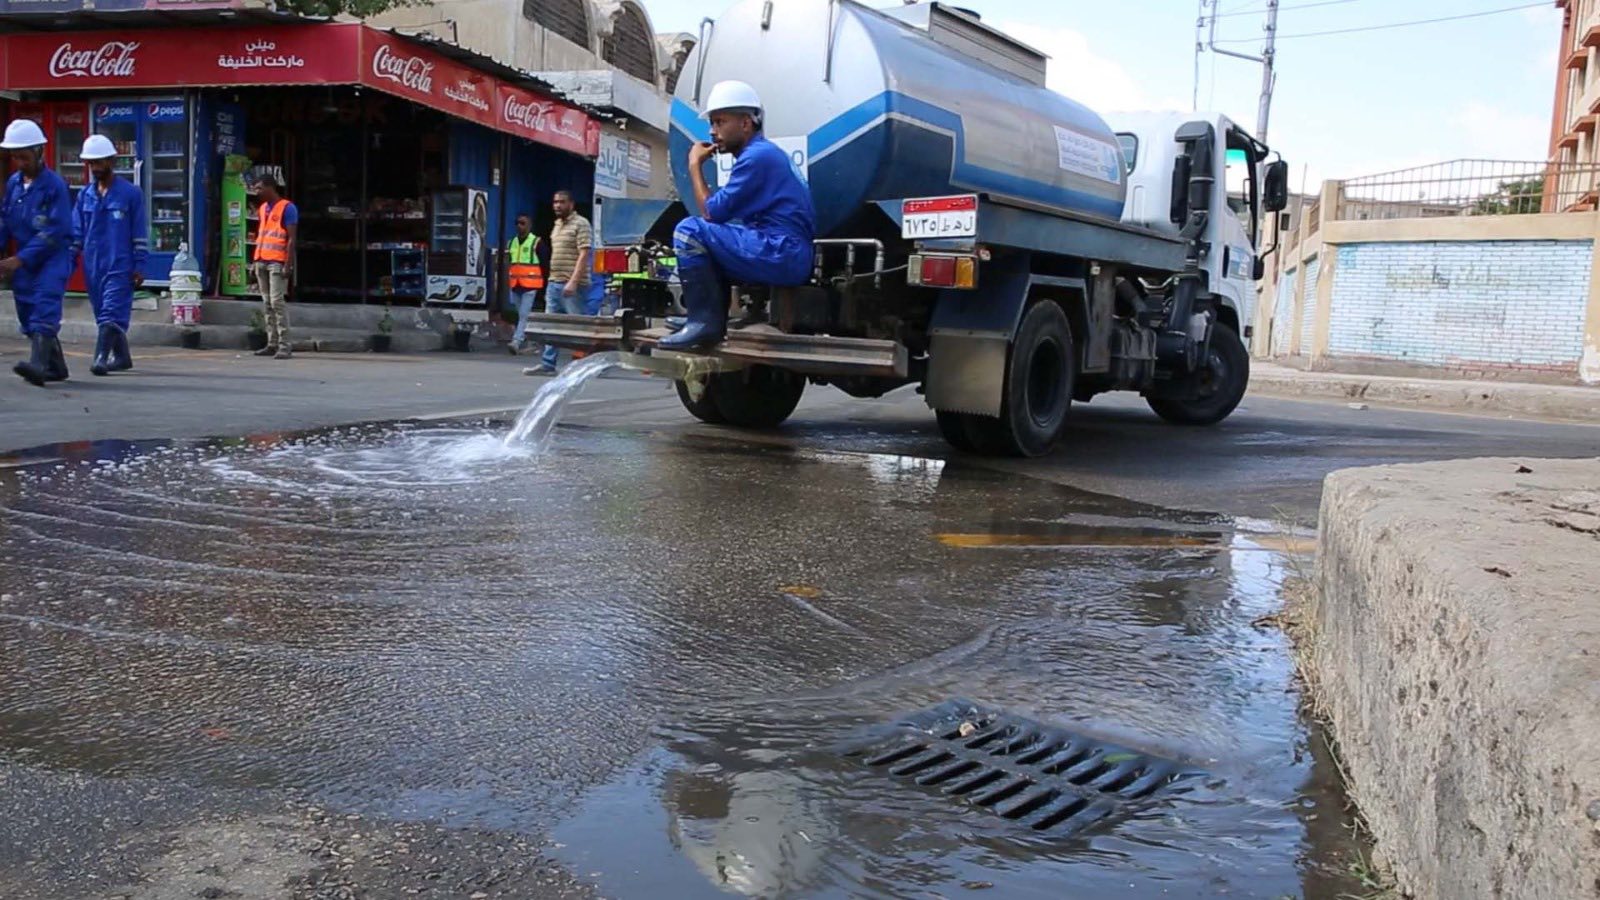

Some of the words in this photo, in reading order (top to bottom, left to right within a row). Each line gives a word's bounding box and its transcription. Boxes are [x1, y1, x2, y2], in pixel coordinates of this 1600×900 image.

[245, 38, 276, 55] ميني
[49, 41, 141, 78] Coca-Cola
[218, 54, 262, 69] الخليفة
[264, 54, 305, 68] ماركت
[372, 44, 435, 95] Coca-Cola
[109, 106, 133, 117] pepsi
[160, 105, 184, 117] pepsi
